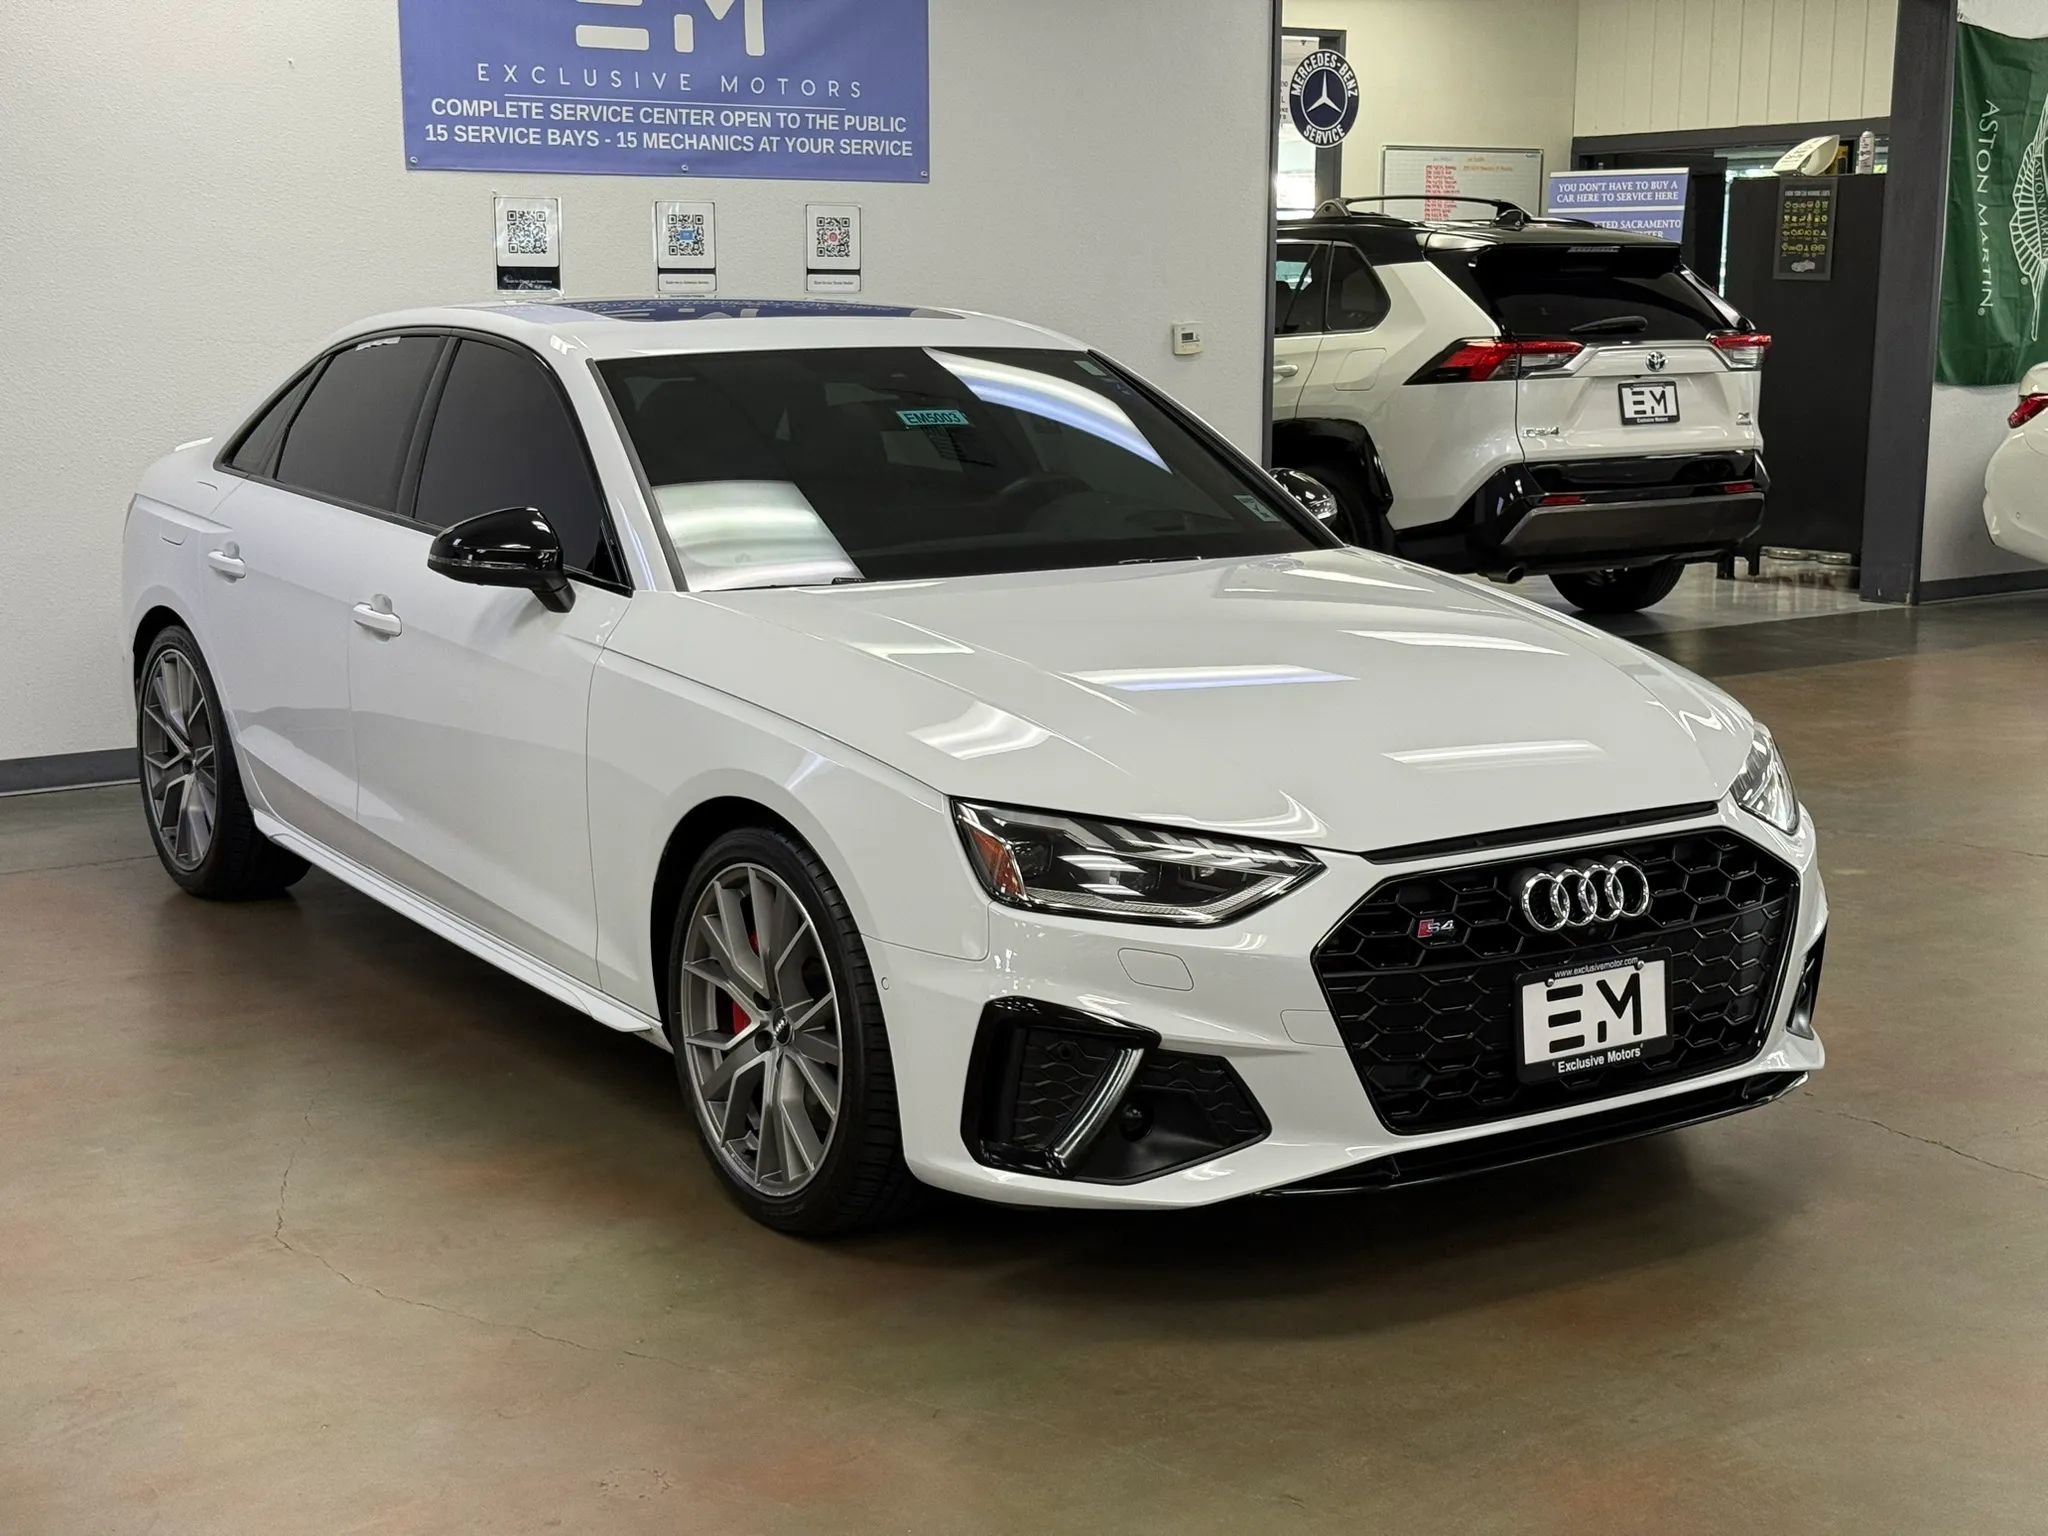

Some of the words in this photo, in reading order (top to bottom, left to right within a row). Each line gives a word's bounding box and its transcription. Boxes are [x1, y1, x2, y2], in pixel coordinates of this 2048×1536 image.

[477, 63, 691, 91] EXCLUSIVE
[720, 75, 861, 98] MOTORS
[1291, 53, 1358, 97] MERCEDES-BENZ
[431, 98, 544, 119] COMPLETE
[550, 103, 634, 123] SERVICE
[639, 107, 715, 126] CENTER
[720, 111, 772, 128] OPEN
[776, 112, 800, 129] TO
[805, 113, 840, 131] THE
[844, 115, 907, 133] PUBLIC
[425, 124, 448, 142] 15
[454, 125, 542, 145] SERVICE
[548, 129, 600, 147] BAYS
[616, 131, 637, 148] 15
[643, 132, 754, 152] MECHANICS
[758, 136, 781, 153] AT
[784, 137, 835, 154] YOUR
[839, 139, 913, 157] SERVICE
[1303, 124, 1346, 144] SERVICE
[1976, 99, 2000, 193] ASTON
[1558, 183, 1577, 192] YOU
[1579, 182, 1607, 192] DON'T
[1609, 181, 1634, 191] HAVE
[1636, 181, 1649, 190] TO
[1651, 181, 1670, 190] BUY
[1670, 180, 1679, 189] A
[2033, 159, 2046, 203] ASTON
[1556, 194, 1576, 203] CAR
[1577, 193, 1600, 203] HERE
[1601, 193, 1615, 202] TO
[1616, 192, 1653, 201] SERVICE
[1654, 191, 1679, 200] HERE
[1619, 219, 1681, 229] SACRAMENTO
[1978, 203, 1993, 307] MARTIN
[1631, 390, 1668, 415] EM
[903, 412, 961, 424] EM5003
[1554, 956, 1639, 978] www.exclusivemotor.com
[1546, 972, 1643, 1054] EM
[1557, 1055, 1605, 1074] Exclusive
[1607, 1047, 1641, 1063] Motors
